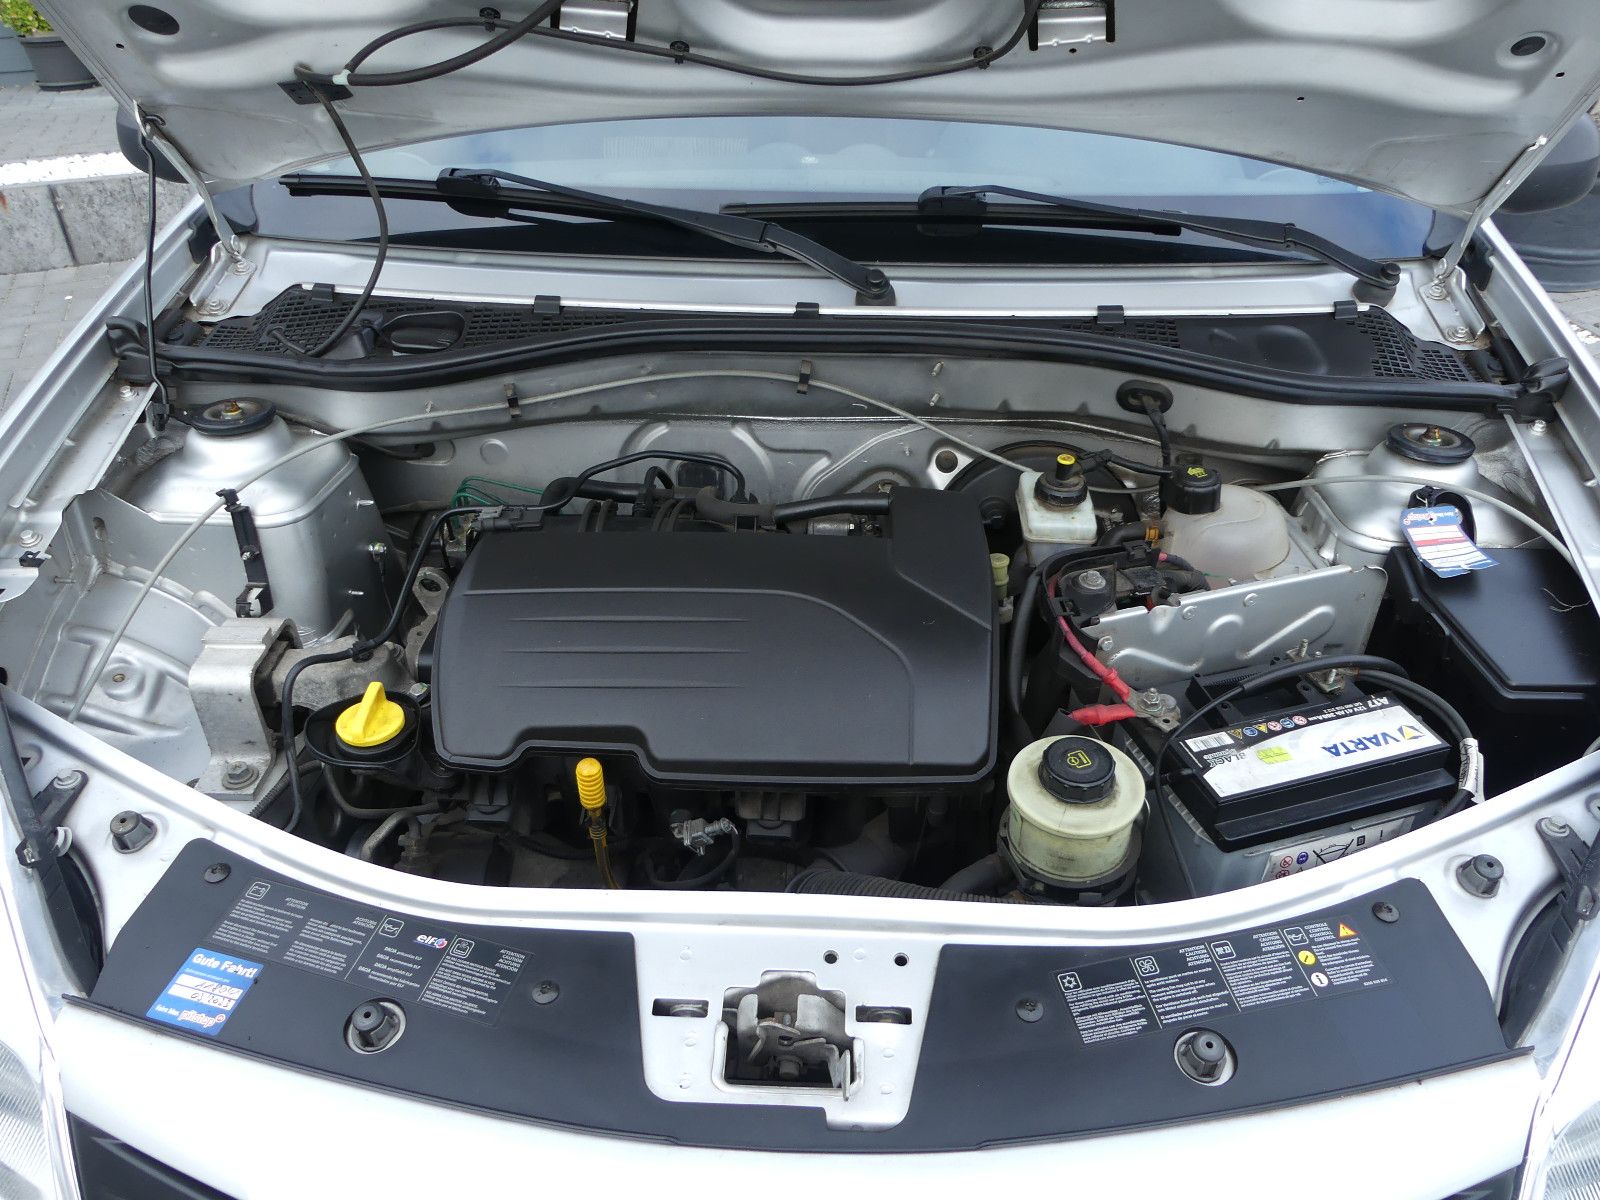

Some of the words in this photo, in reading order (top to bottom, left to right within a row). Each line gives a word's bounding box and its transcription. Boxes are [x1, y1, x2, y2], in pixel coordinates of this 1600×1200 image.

[1320, 731, 1401, 757] VARTA
[416, 934, 438, 945] elf
[191, 953, 220, 969] Gute
[220, 960, 258, 978] Fahrt!
